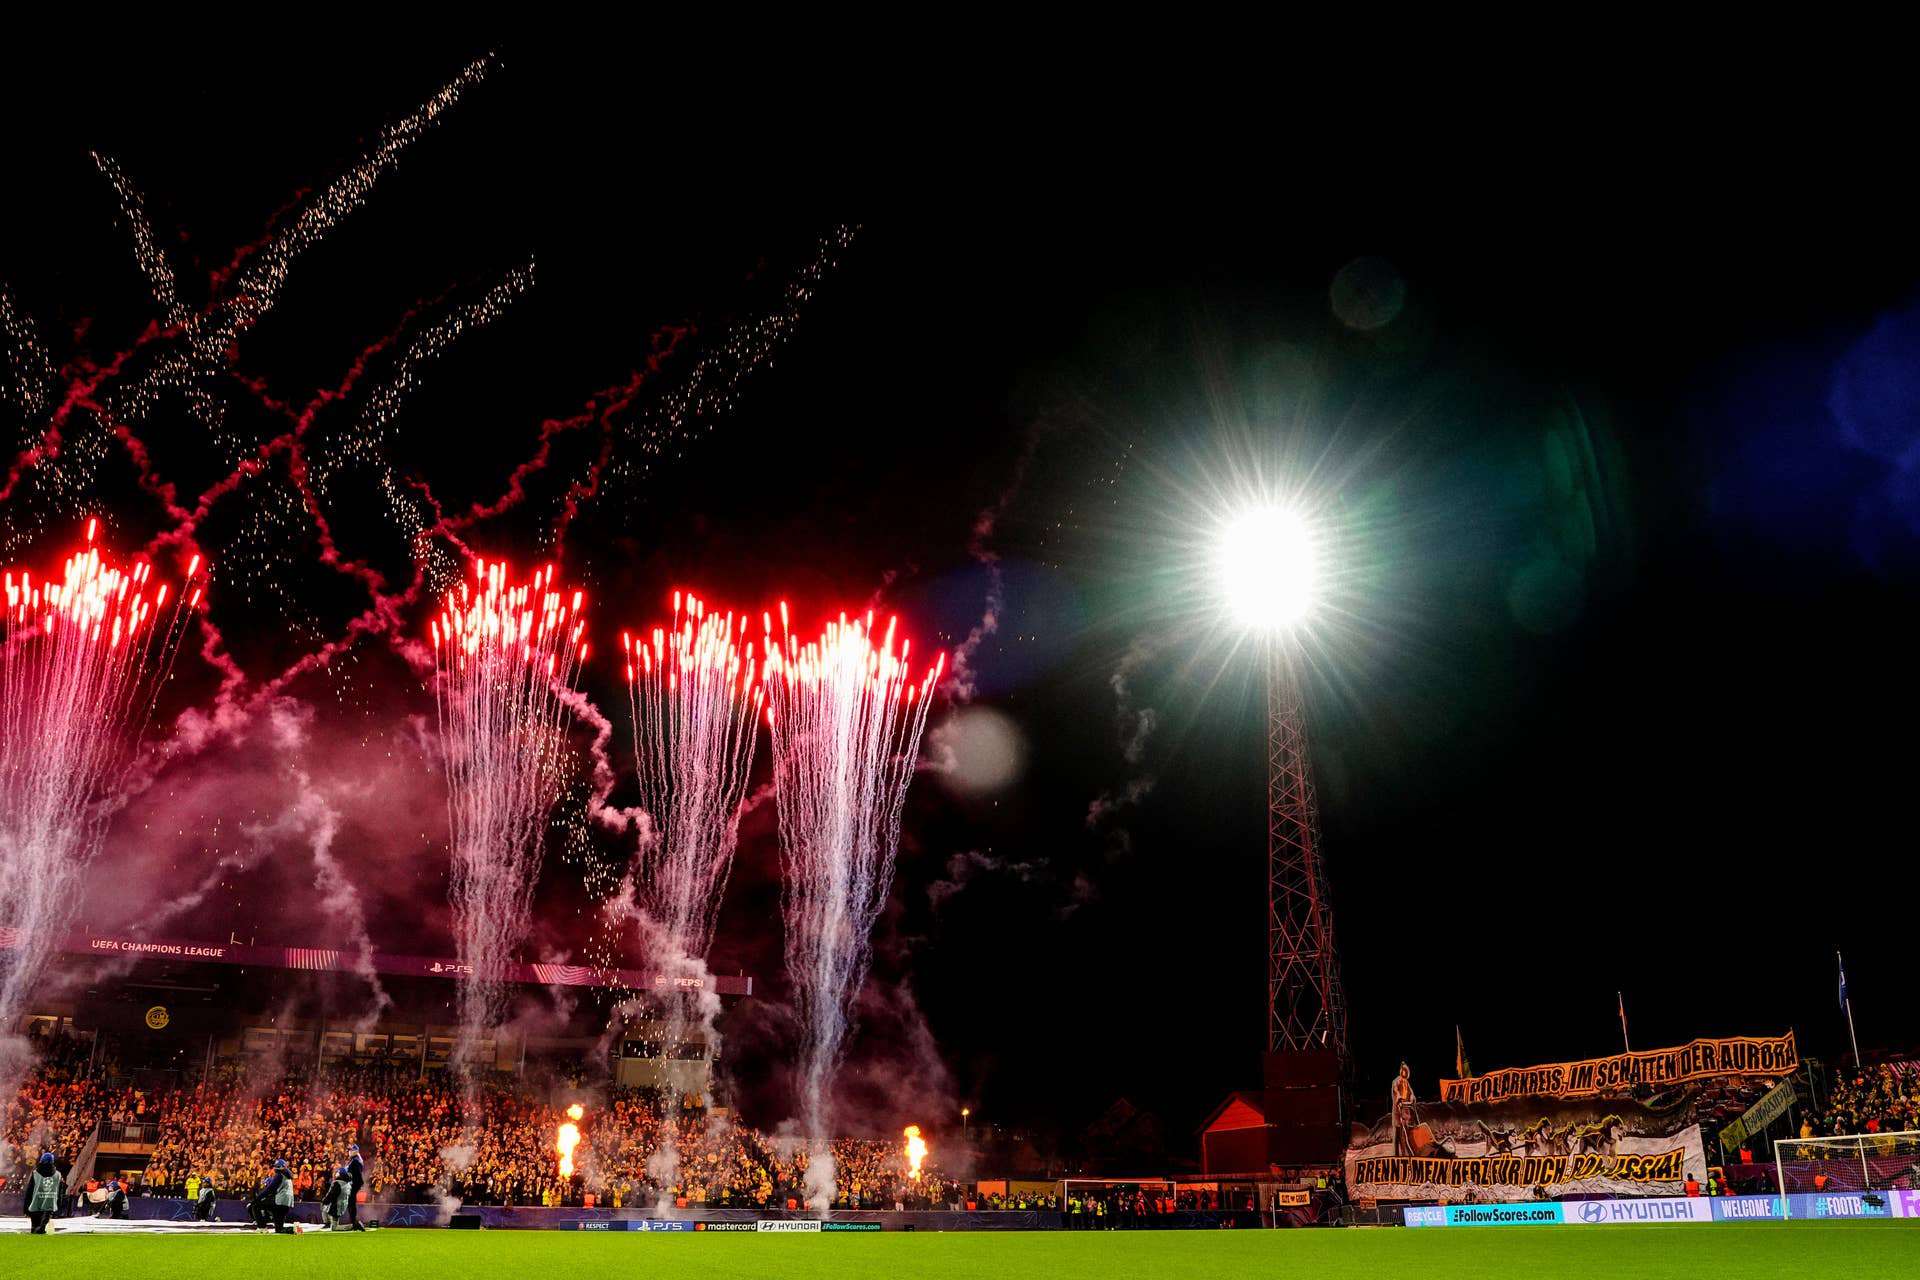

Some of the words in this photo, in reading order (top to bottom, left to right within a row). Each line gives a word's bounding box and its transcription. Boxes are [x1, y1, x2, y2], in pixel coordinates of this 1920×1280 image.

[92, 940, 119, 950] UEFA
[121, 942, 182, 954] CHAMPIONS
[184, 946, 224, 957] LEAGUE
[445, 964, 474, 974] PS5
[673, 977, 704, 988] PEPSI
[1568, 1064, 1594, 1091] IM
[1596, 1054, 1677, 1087] SCHATTEN
[1680, 1044, 1717, 1075] DER
[1355, 1158, 1409, 1185] BRENNT
[1411, 1159, 1449, 1185] MEIN
[1451, 1159, 1490, 1185] HERZ
[1491, 1153, 1521, 1185] FÜR
[1611, 1201, 1694, 1220] HYUNDAI
[1721, 1197, 1771, 1217] WELCOME
[1407, 1210, 1442, 1222] RECYCLE
[653, 1222, 683, 1231] PS5
[707, 1222, 757, 1231] mastercard
[778, 1222, 819, 1230] HYUNDAI
